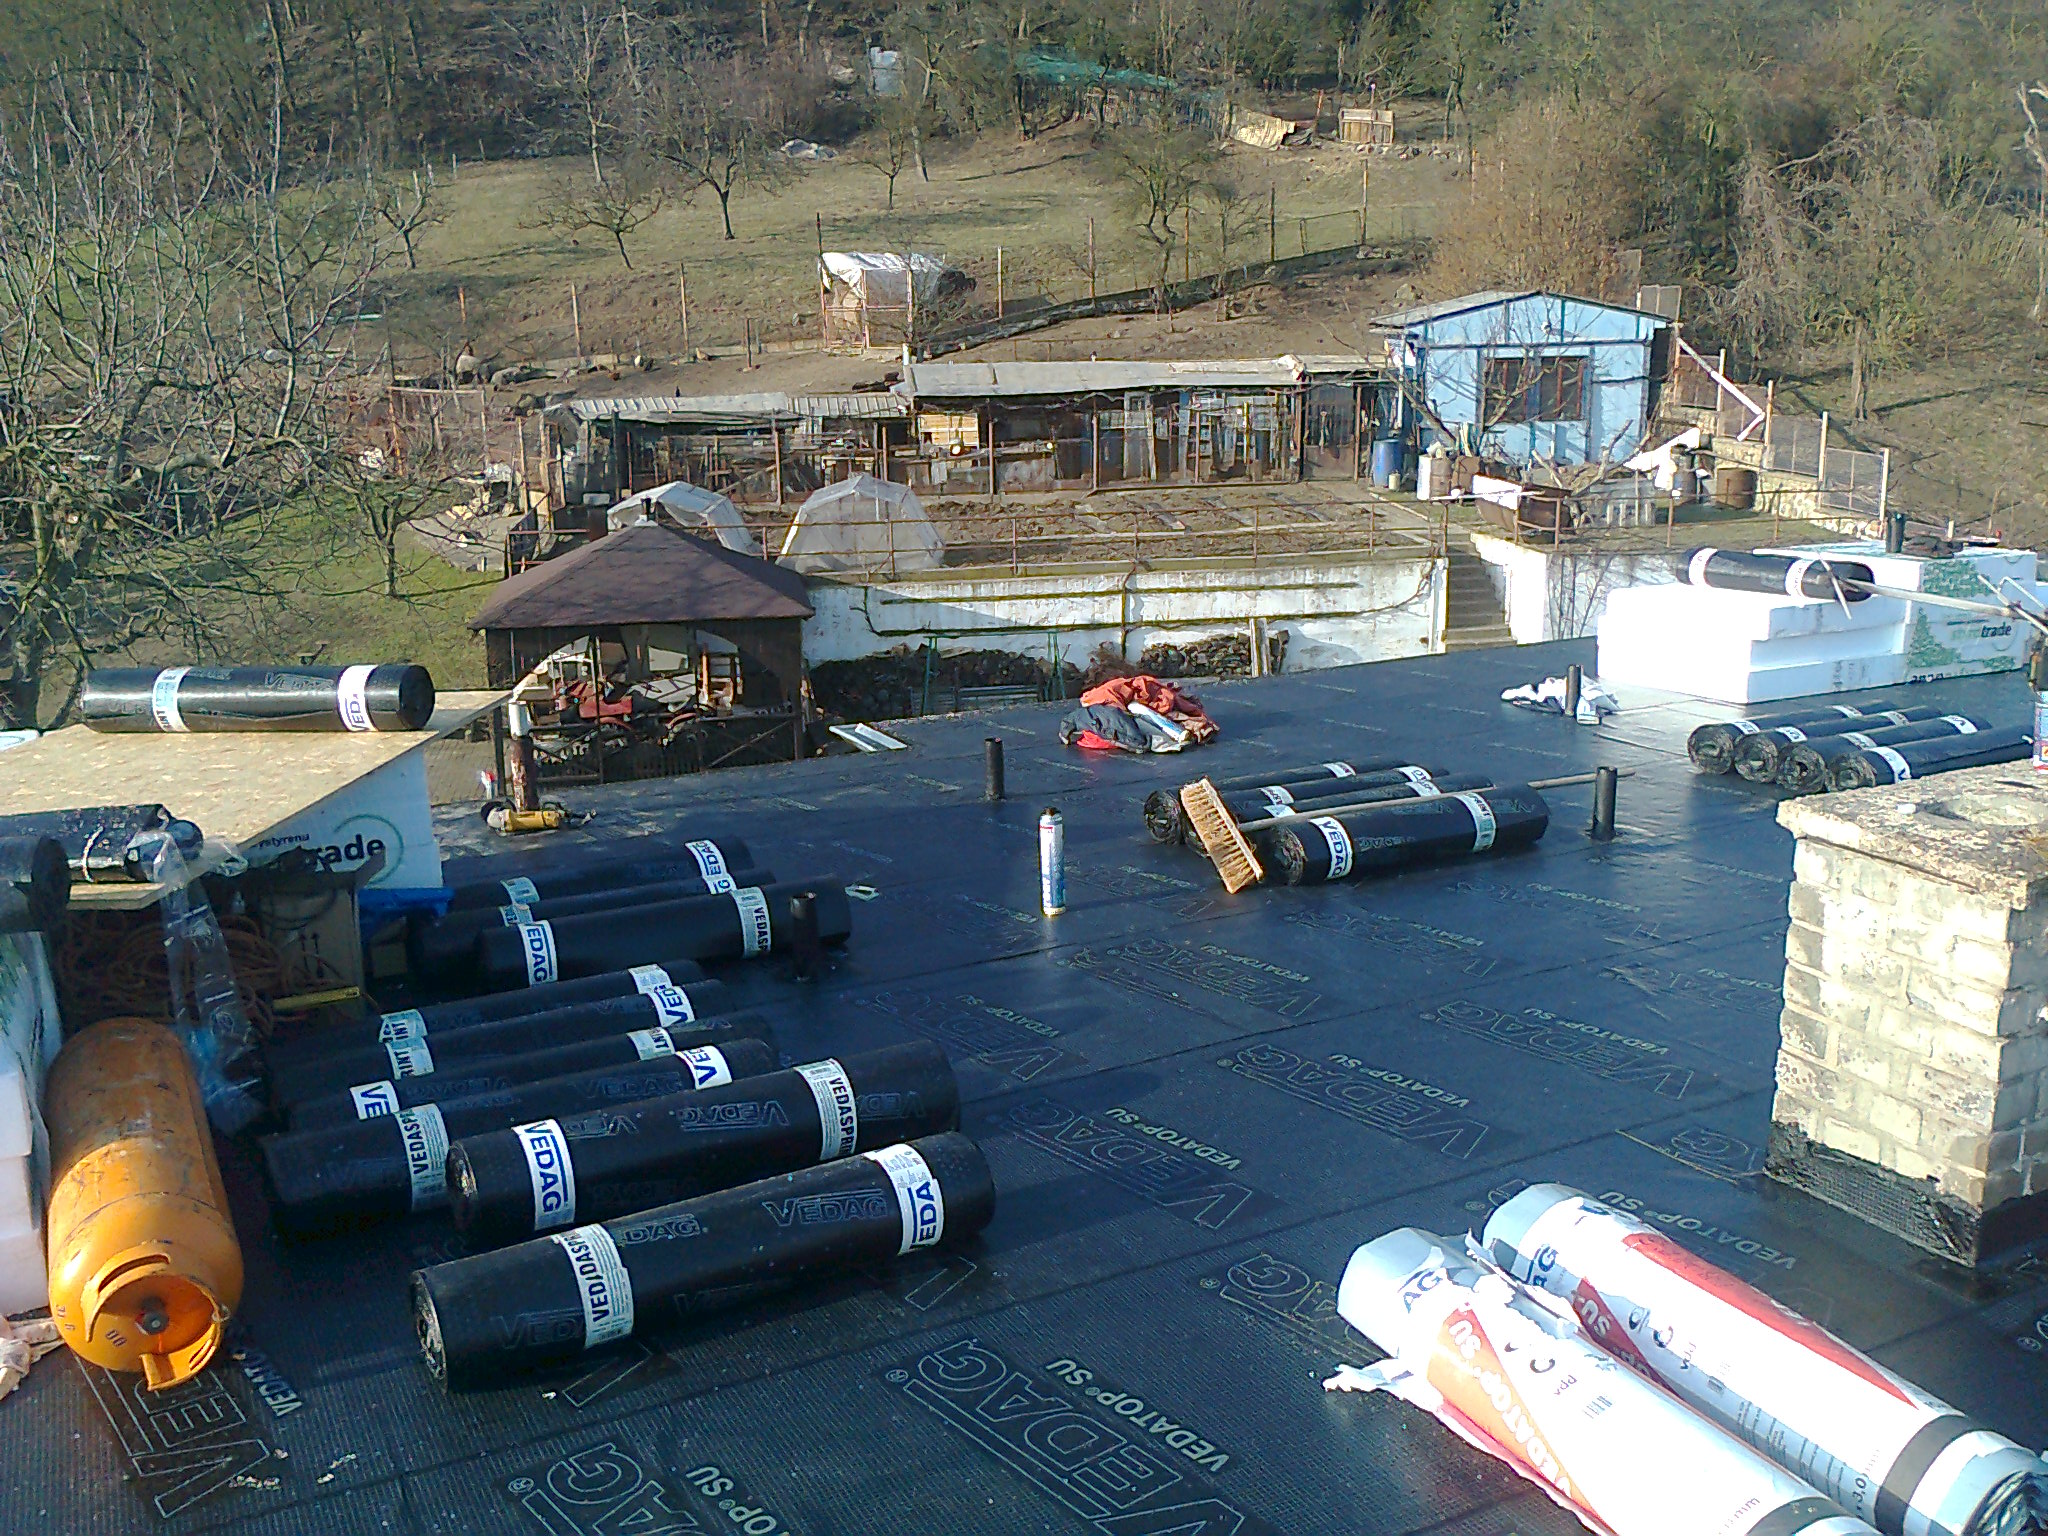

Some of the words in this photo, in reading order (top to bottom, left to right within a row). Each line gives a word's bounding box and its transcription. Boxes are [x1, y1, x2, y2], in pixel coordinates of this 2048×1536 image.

[525, 926, 549, 983] EDAG
[1328, 1053, 1363, 1070] SU
[360, 1084, 391, 1119] VE
[1105, 1107, 1140, 1125] SU
[1145, 1125, 1243, 1171] VEDATOP
[524, 1121, 562, 1214] VEDAG
[1599, 1190, 1645, 1212] SU
[1045, 1358, 1093, 1386] SU
[1095, 1390, 1230, 1473] VEDATOP
[685, 1465, 735, 1497] SU
